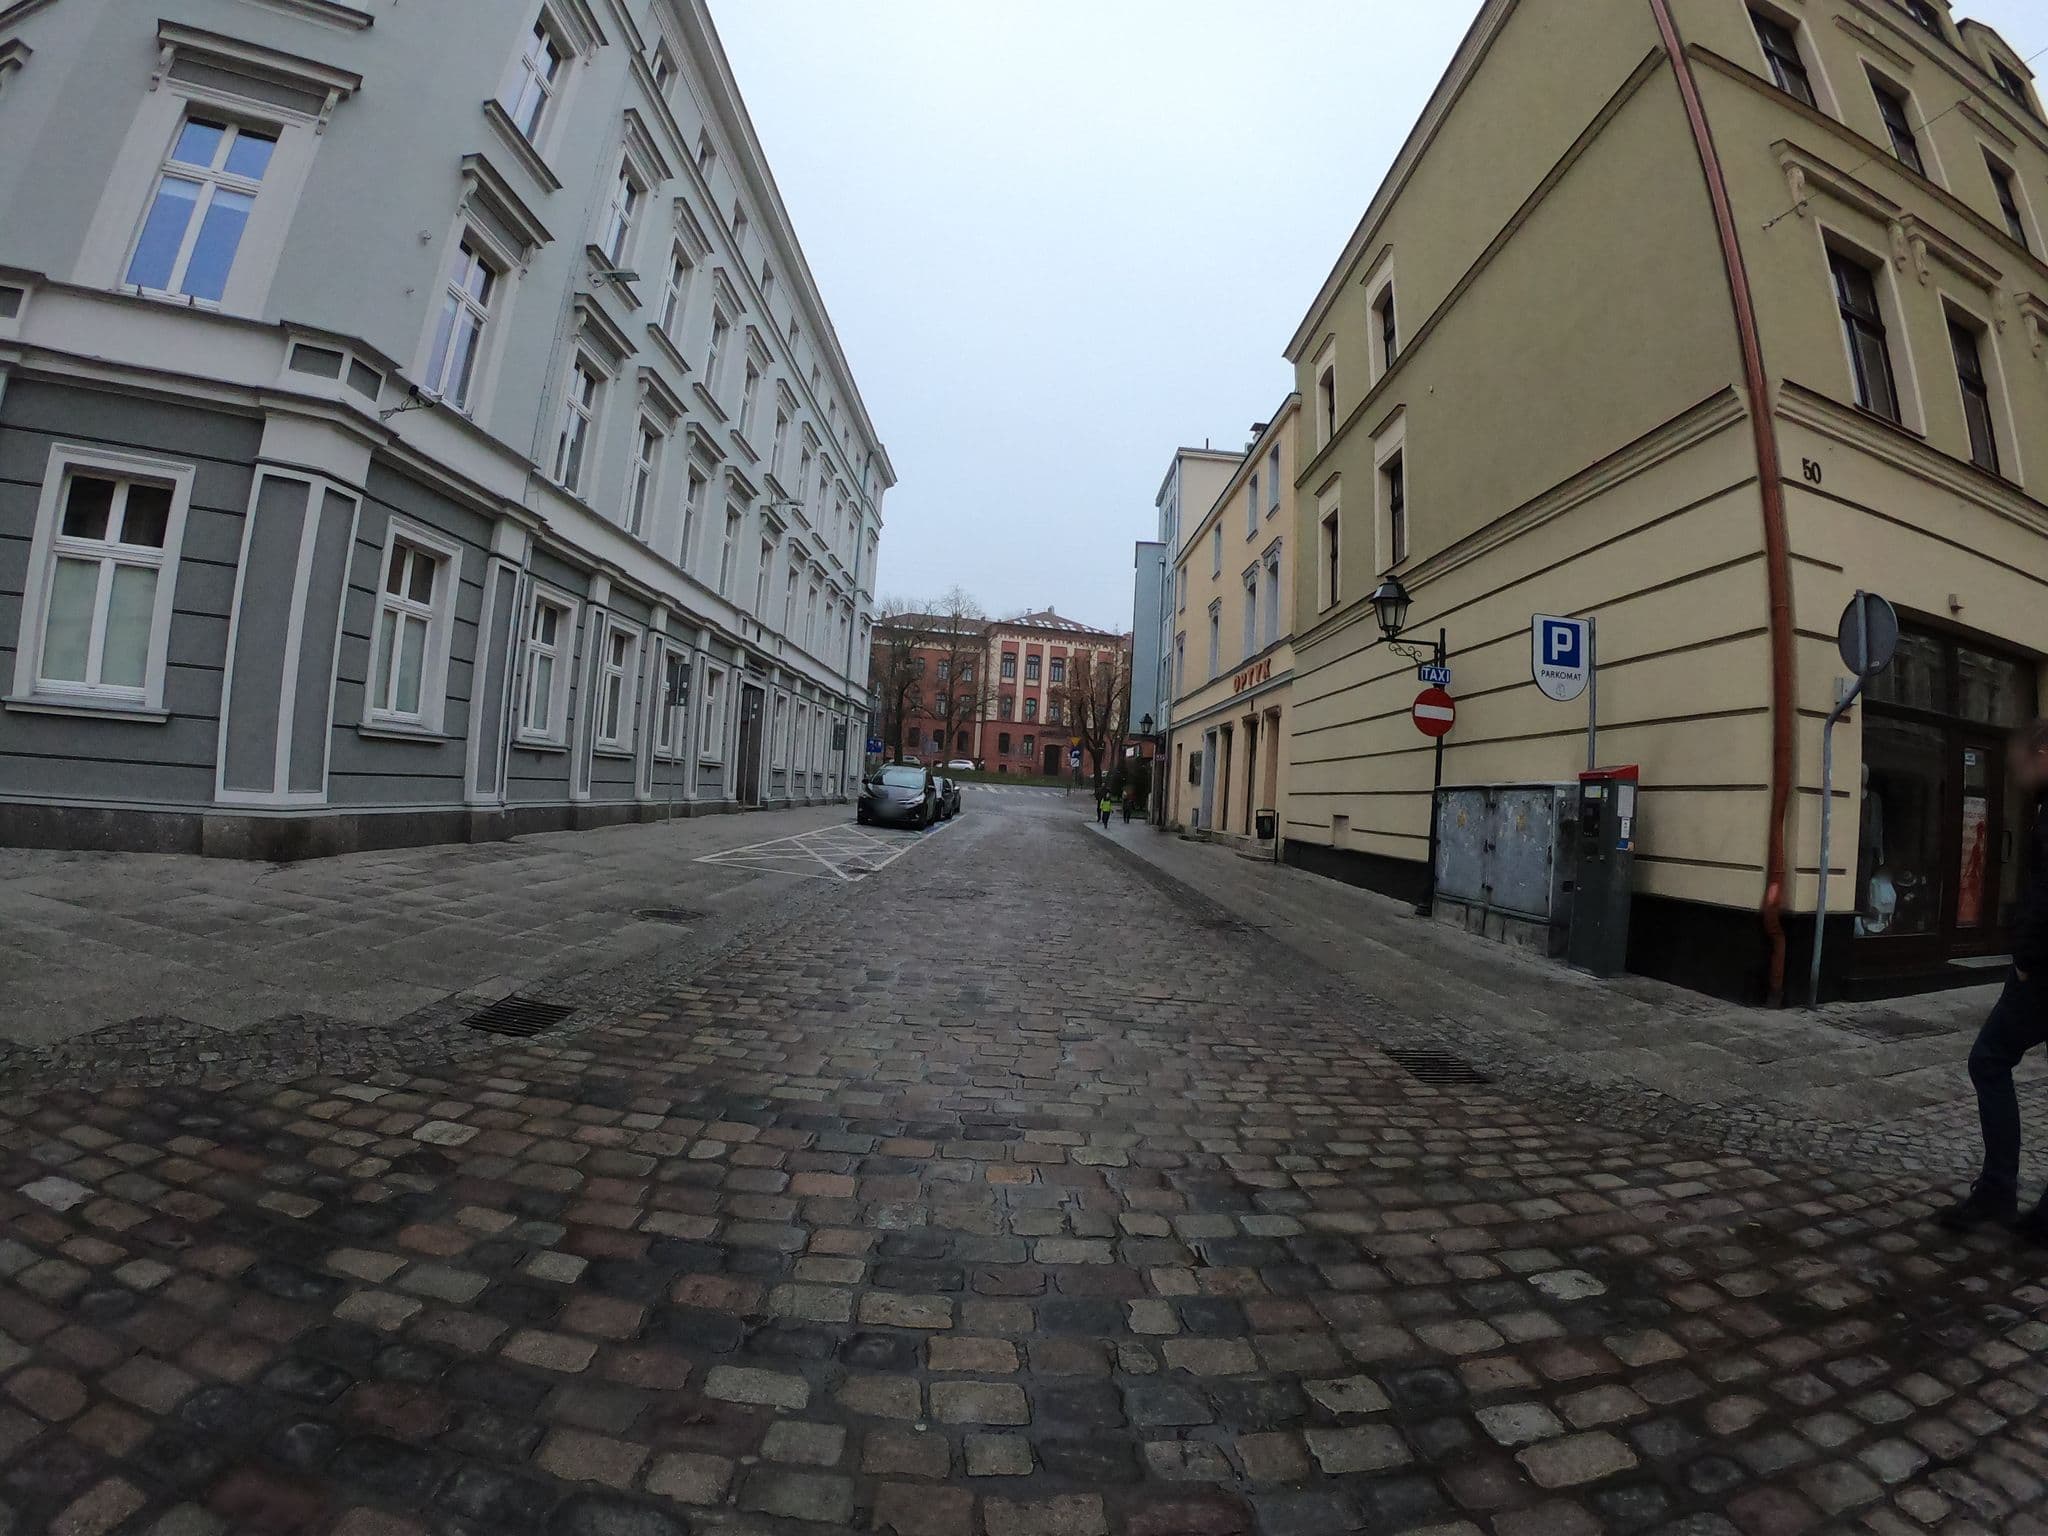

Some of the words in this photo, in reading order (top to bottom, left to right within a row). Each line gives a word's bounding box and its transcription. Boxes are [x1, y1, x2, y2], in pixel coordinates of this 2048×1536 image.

[1802, 457, 1822, 484] 50
[1551, 626, 1573, 660] P
[1233, 657, 1271, 693] OPTYK
[1423, 667, 1450, 682] TAXI
[1541, 669, 1582, 680] PARKOMAT
